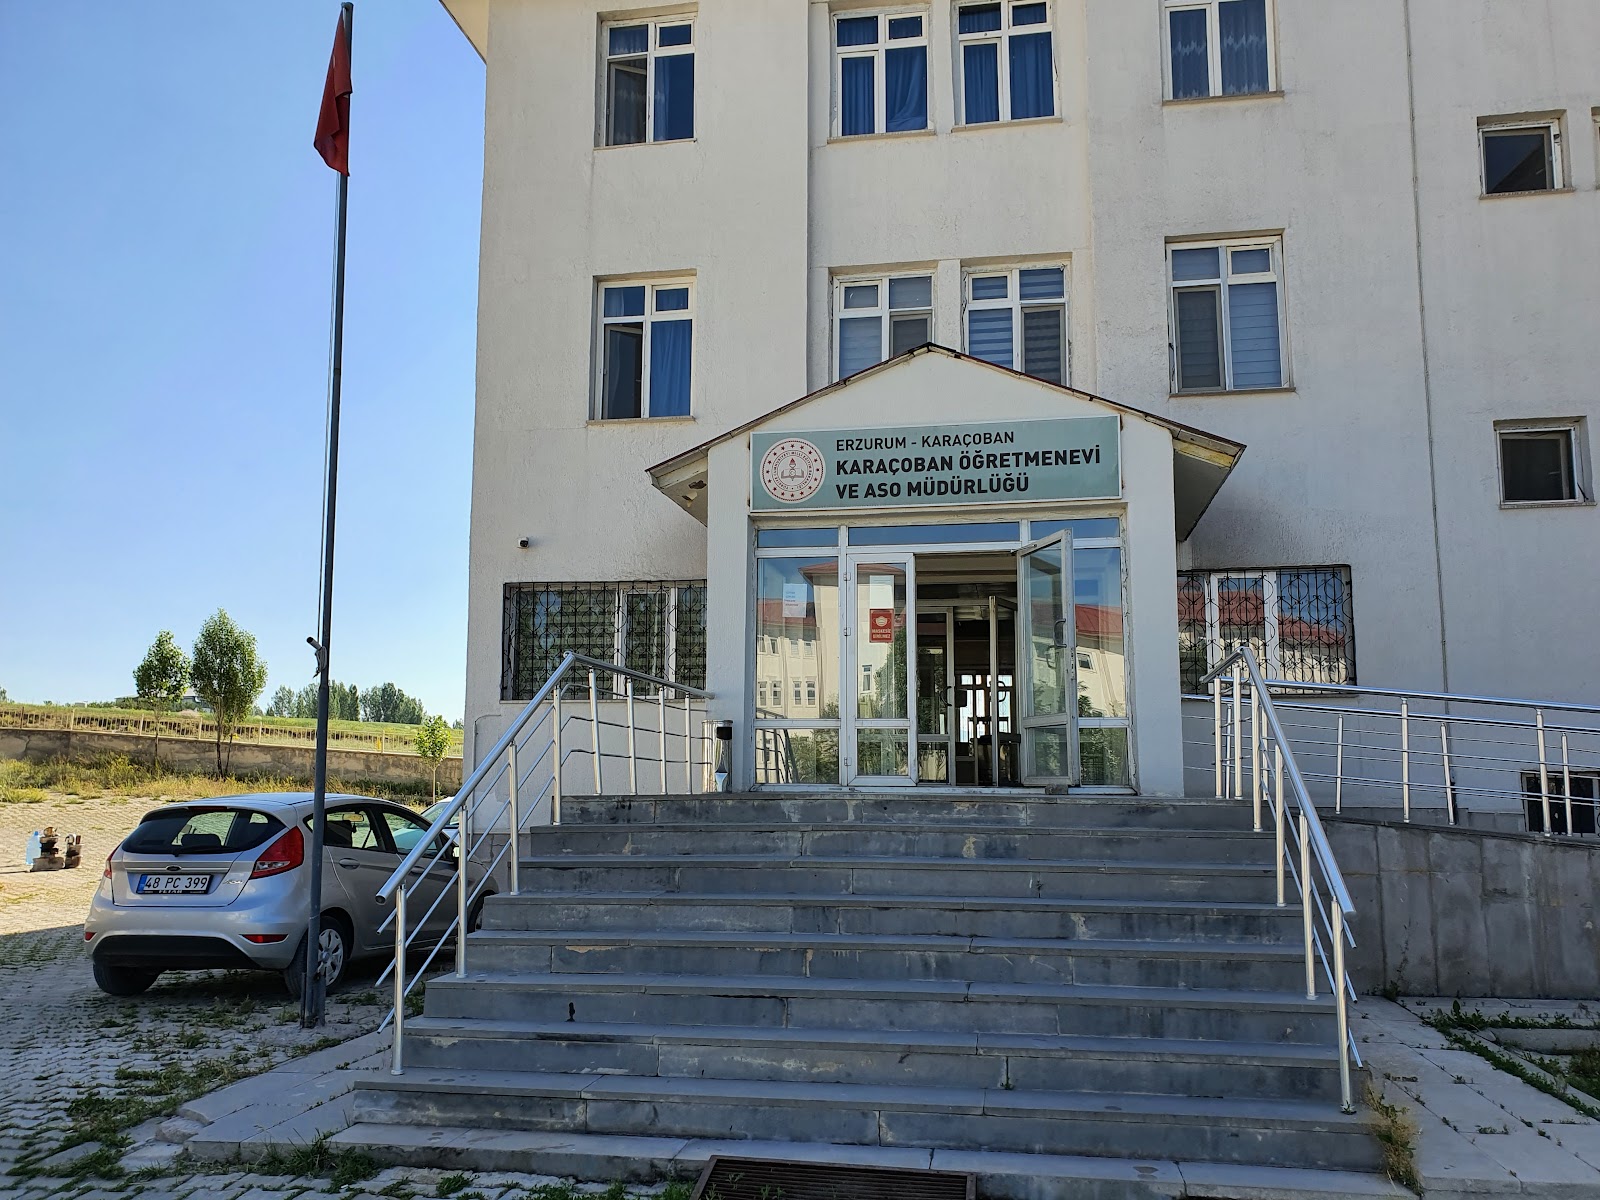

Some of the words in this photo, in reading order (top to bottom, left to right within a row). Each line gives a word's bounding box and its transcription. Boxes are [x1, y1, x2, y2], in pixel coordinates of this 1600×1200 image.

[836, 436, 906, 451] ERZURUM
[921, 431, 1014, 448] KARAÇOBAN
[836, 455, 953, 476] KARAÇOBAN
[959, 444, 1100, 471] ÖĞRETMENEVİ
[835, 483, 859, 499] VE
[863, 482, 902, 498] ASO
[907, 472, 1029, 497] MÜDÜRLÜĞÜ
[145, 877, 160, 889] 48
[165, 877, 181, 889] PC
[184, 877, 208, 889] 399
